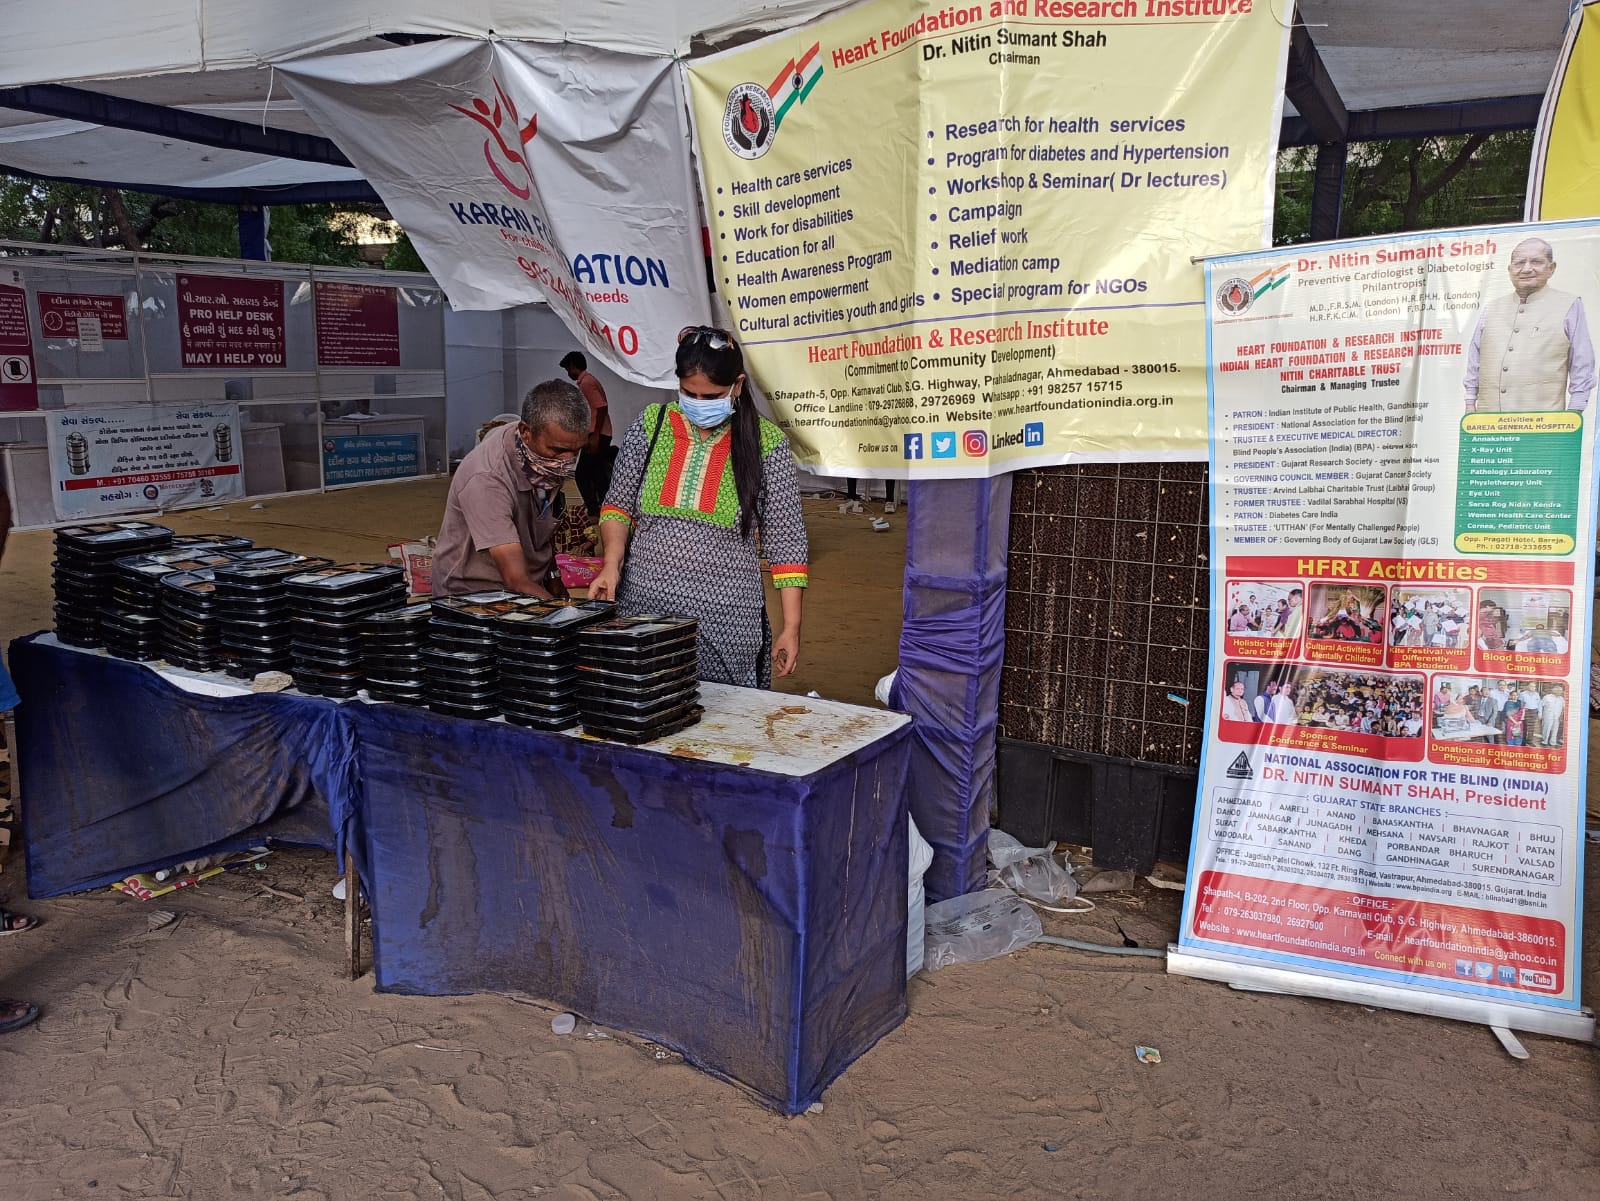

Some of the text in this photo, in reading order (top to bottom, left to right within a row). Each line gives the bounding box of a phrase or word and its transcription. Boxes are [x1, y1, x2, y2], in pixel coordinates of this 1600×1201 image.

[832, 0, 1252, 68] Heart Foundation and Research Institute
[923, 28, 1107, 62] Dr. Nitin Sumant Shah
[989, 52, 1040, 66] Chairman
[946, 116, 1186, 141] Research for health services
[946, 142, 1229, 168] Program for diabetes and Hypertension
[731, 158, 852, 196] Health care services
[947, 172, 1024, 196] Workshop
[1028, 172, 1038, 188] &
[1120, 172, 1142, 188] Dr
[1147, 170, 1228, 190] lectures)
[733, 184, 841, 219] Skill development
[948, 200, 1023, 223] Campaign
[449, 202, 533, 235] KARAN
[734, 208, 854, 242] Work for disabilities
[736, 235, 835, 265] Education for all
[950, 228, 1028, 250] Relief work
[737, 249, 892, 287] Health Awareness Program
[950, 254, 1060, 277] Mediation camp
[1297, 240, 1497, 272] Dr. Nitin Sumant Shah
[1298, 273, 1351, 288] Preventive
[1354, 268, 1414, 282] Cardiologist
[1427, 261, 1495, 275] Diabetologist
[1362, 278, 1427, 294] Philantropist
[586, 288, 630, 304] needs
[738, 278, 869, 310] Women empowerment
[952, 278, 1148, 306] Special program for NGOs
[189, 308, 274, 322] PRO HELP DESK
[739, 292, 925, 332] Cultural activities youth and girls
[808, 318, 1109, 364] Heart Foundation & Research Institute
[1236, 342, 1265, 357] HEART
[1270, 338, 1327, 354] FOUNDATION
[1332, 337, 1340, 348] &
[1345, 332, 1395, 348] RESEARCH
[186, 352, 282, 364] MAY I HELP YOU
[1280, 362, 1402, 382] NITIN CHARITABLE TRUST
[1281, 378, 1400, 394] Chairman & Managing Trustee
[795, 395, 1174, 428] heartfoundationindia@yahoo.co.in Website www.heartfoundationindia.org.in
[1234, 511, 1338, 520] PATRON Diabetes Care India
[1296, 558, 1489, 581] HFRI Activities
[1482, 652, 1562, 665] Blood Donation
[1506, 664, 1536, 674] Camp
[1264, 752, 1550, 795] NATIONAL ASSOCIATION FOR THE BLIND (INDIA)
[1262, 766, 1547, 811] DR. NITIN SUMANT SHAH, President
[1312, 794, 1442, 817] GUJARAT STATE BRANCHES
[1248, 811, 1292, 824] JAMNAGAR
[1306, 819, 1353, 832] JUNAGADH
[1366, 829, 1404, 839] MEHSANA
[1418, 833, 1456, 844] NAVSARI
[1472, 838, 1510, 850] RAJKOT
[1526, 846, 1556, 856] PATAN
[1279, 804, 1310, 814] AMRELI
[1326, 810, 1356, 821] ANAND
[1372, 818, 1434, 830] BANASKANTHA
[1452, 824, 1510, 838] BHAVNAGAR
[1529, 833, 1556, 844] BHUJ
[1199, 920, 1366, 957] Website www.heartfoundationindia.org.in
